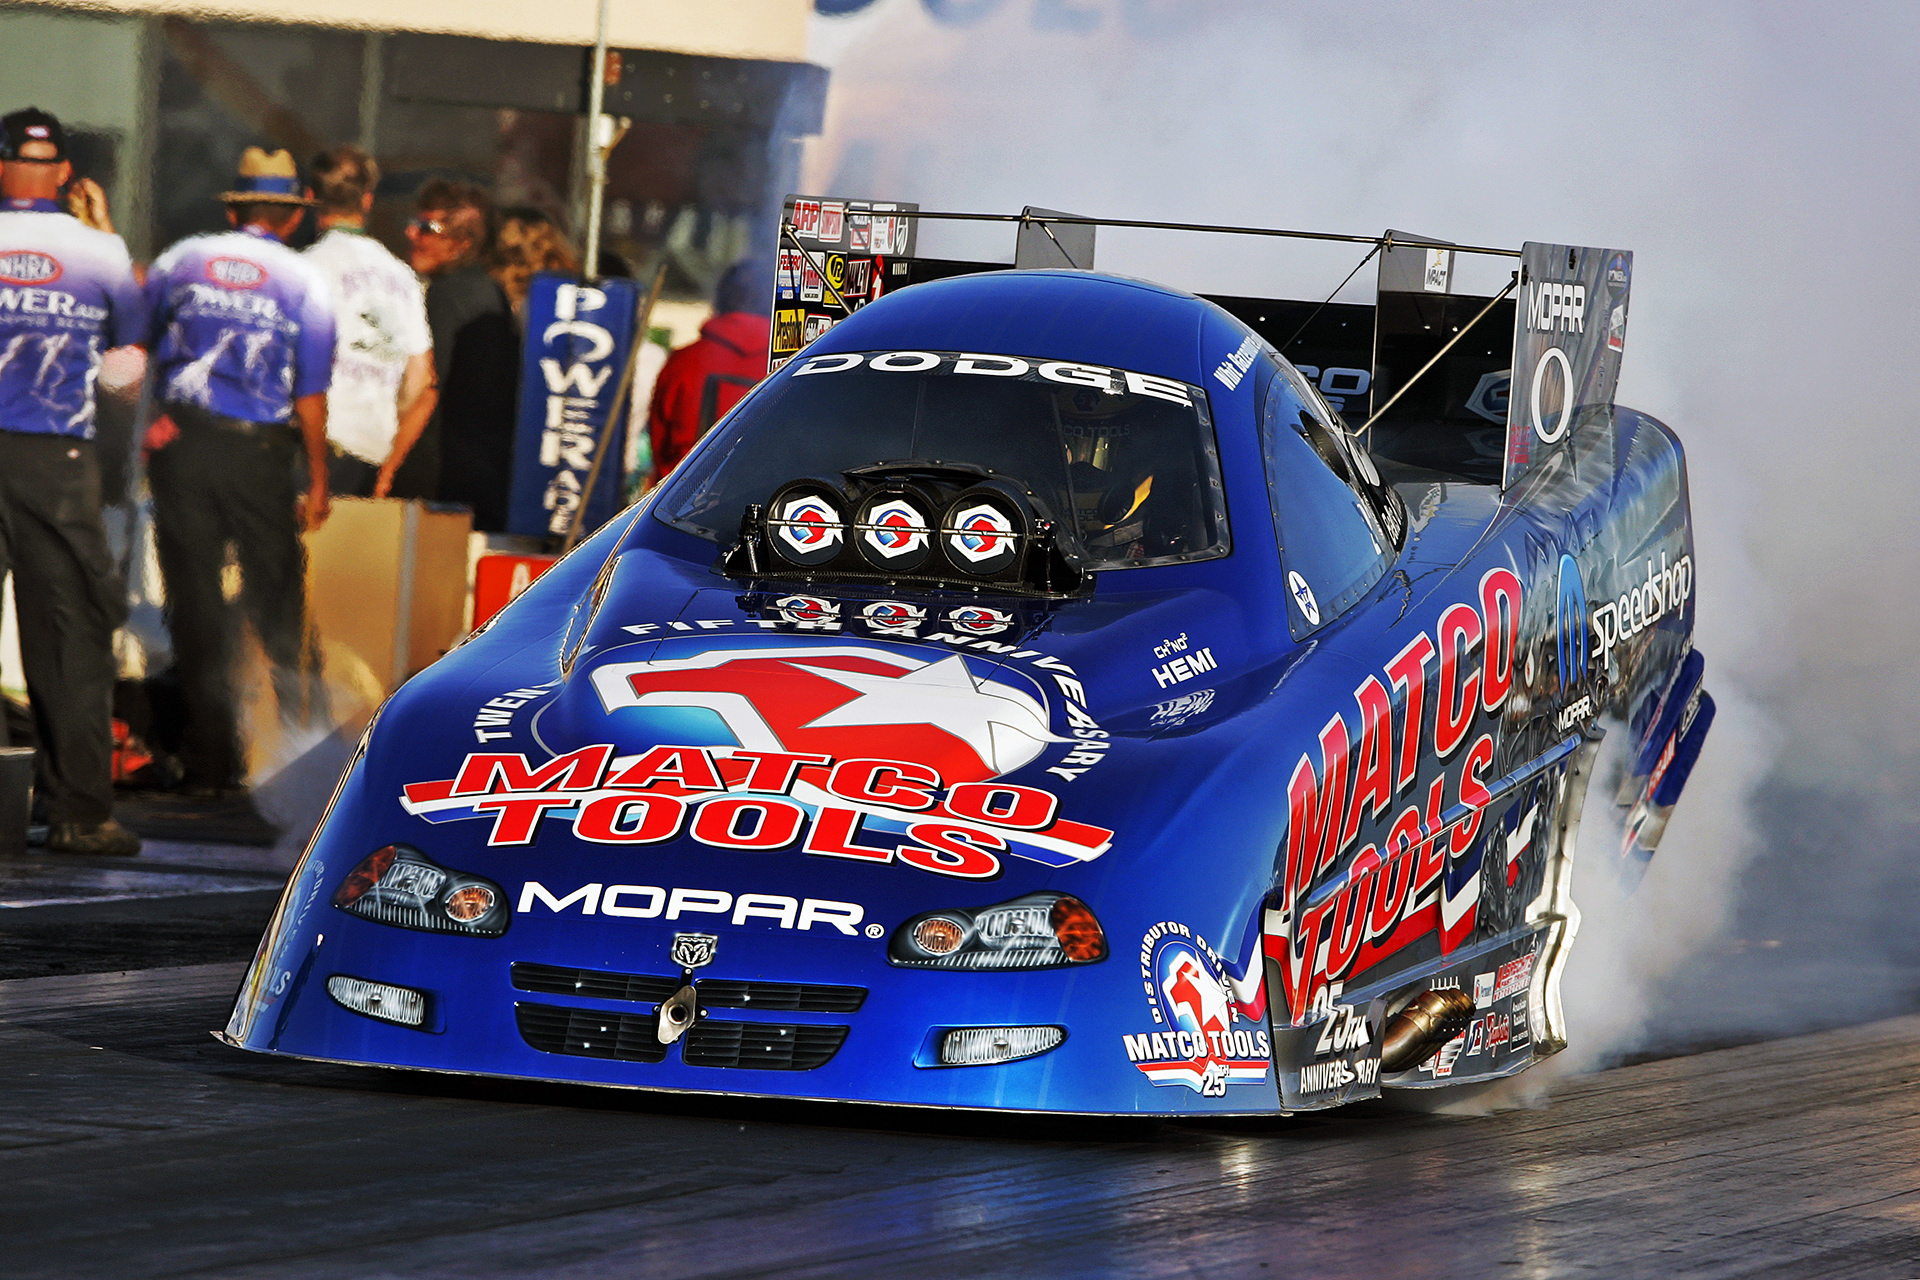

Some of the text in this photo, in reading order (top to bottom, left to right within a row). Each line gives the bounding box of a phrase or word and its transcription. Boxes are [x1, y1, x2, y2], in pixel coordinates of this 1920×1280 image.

[1526, 280, 1586, 334] MOPAR
[791, 352, 1193, 408] DODGE
[1592, 551, 1693, 670] speedshop
[870, 626, 1112, 783] ANNIVERSARY
[1151, 647, 1218, 689] HEMI
[1283, 566, 1524, 912] MATCO
[1557, 695, 1593, 733] MOPAR
[449, 744, 1060, 830] MATCO
[475, 795, 1010, 880] TOOLS
[1292, 733, 1496, 1028] TOOLS
[1140, 920, 1240, 1025] DISTRIBUTOR DRIVEN
[1122, 1029, 1271, 1063] MATCO TOOLS
